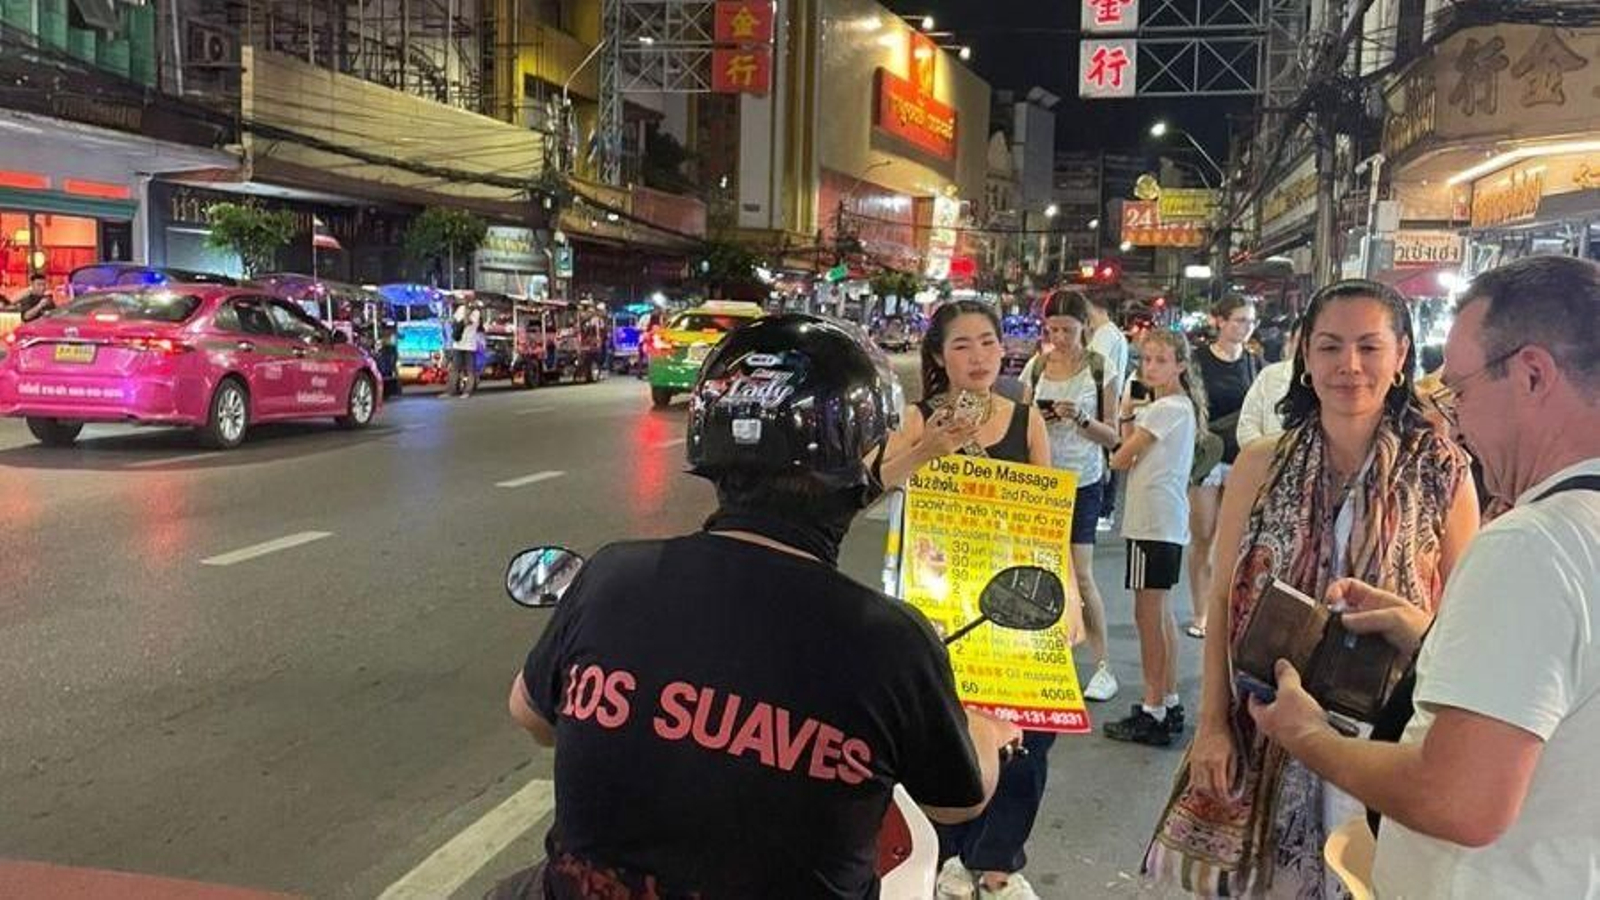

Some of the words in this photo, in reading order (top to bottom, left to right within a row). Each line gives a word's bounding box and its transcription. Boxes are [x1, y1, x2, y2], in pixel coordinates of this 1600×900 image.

[930, 456, 960, 473] Dee
[963, 461, 992, 478] Dee
[996, 466, 1058, 490] Massage
[560, 663, 637, 729] LOS
[653, 681, 874, 785] SUAVES
